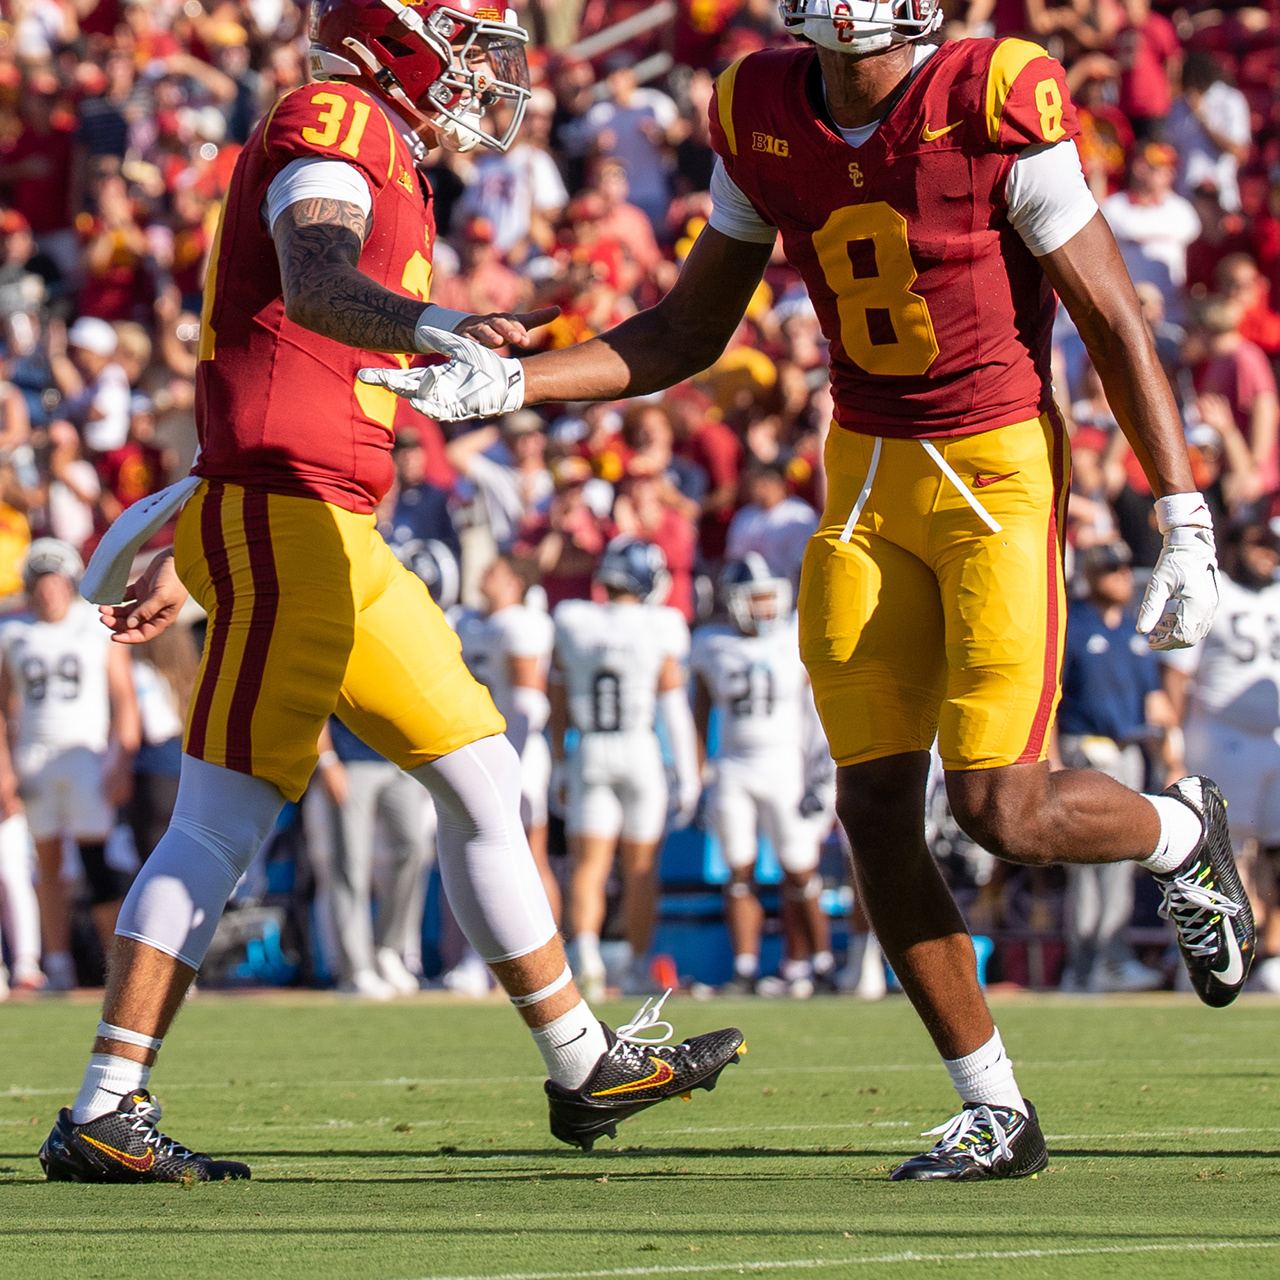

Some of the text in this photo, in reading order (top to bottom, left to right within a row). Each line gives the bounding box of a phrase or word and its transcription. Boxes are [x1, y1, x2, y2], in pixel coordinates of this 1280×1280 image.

[302, 91, 371, 158] 31
[1035, 77, 1066, 142] 8
[812, 201, 940, 376] 8
